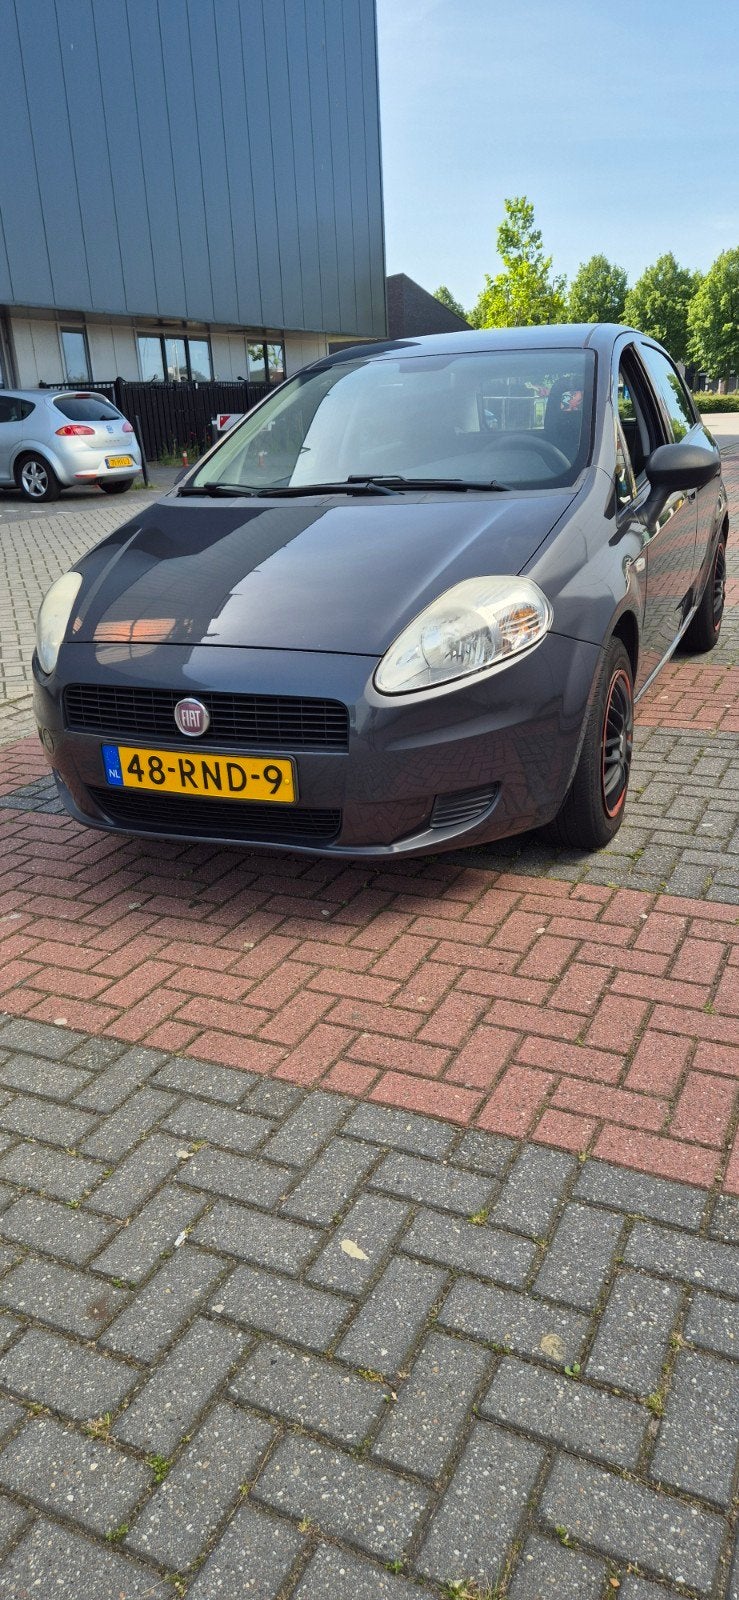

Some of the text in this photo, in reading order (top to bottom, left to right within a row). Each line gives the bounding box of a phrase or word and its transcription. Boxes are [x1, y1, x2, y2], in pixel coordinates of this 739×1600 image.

[181, 709, 200, 727] FIAT
[109, 768, 121, 779] NL
[127, 754, 283, 794] 48-RND-9
